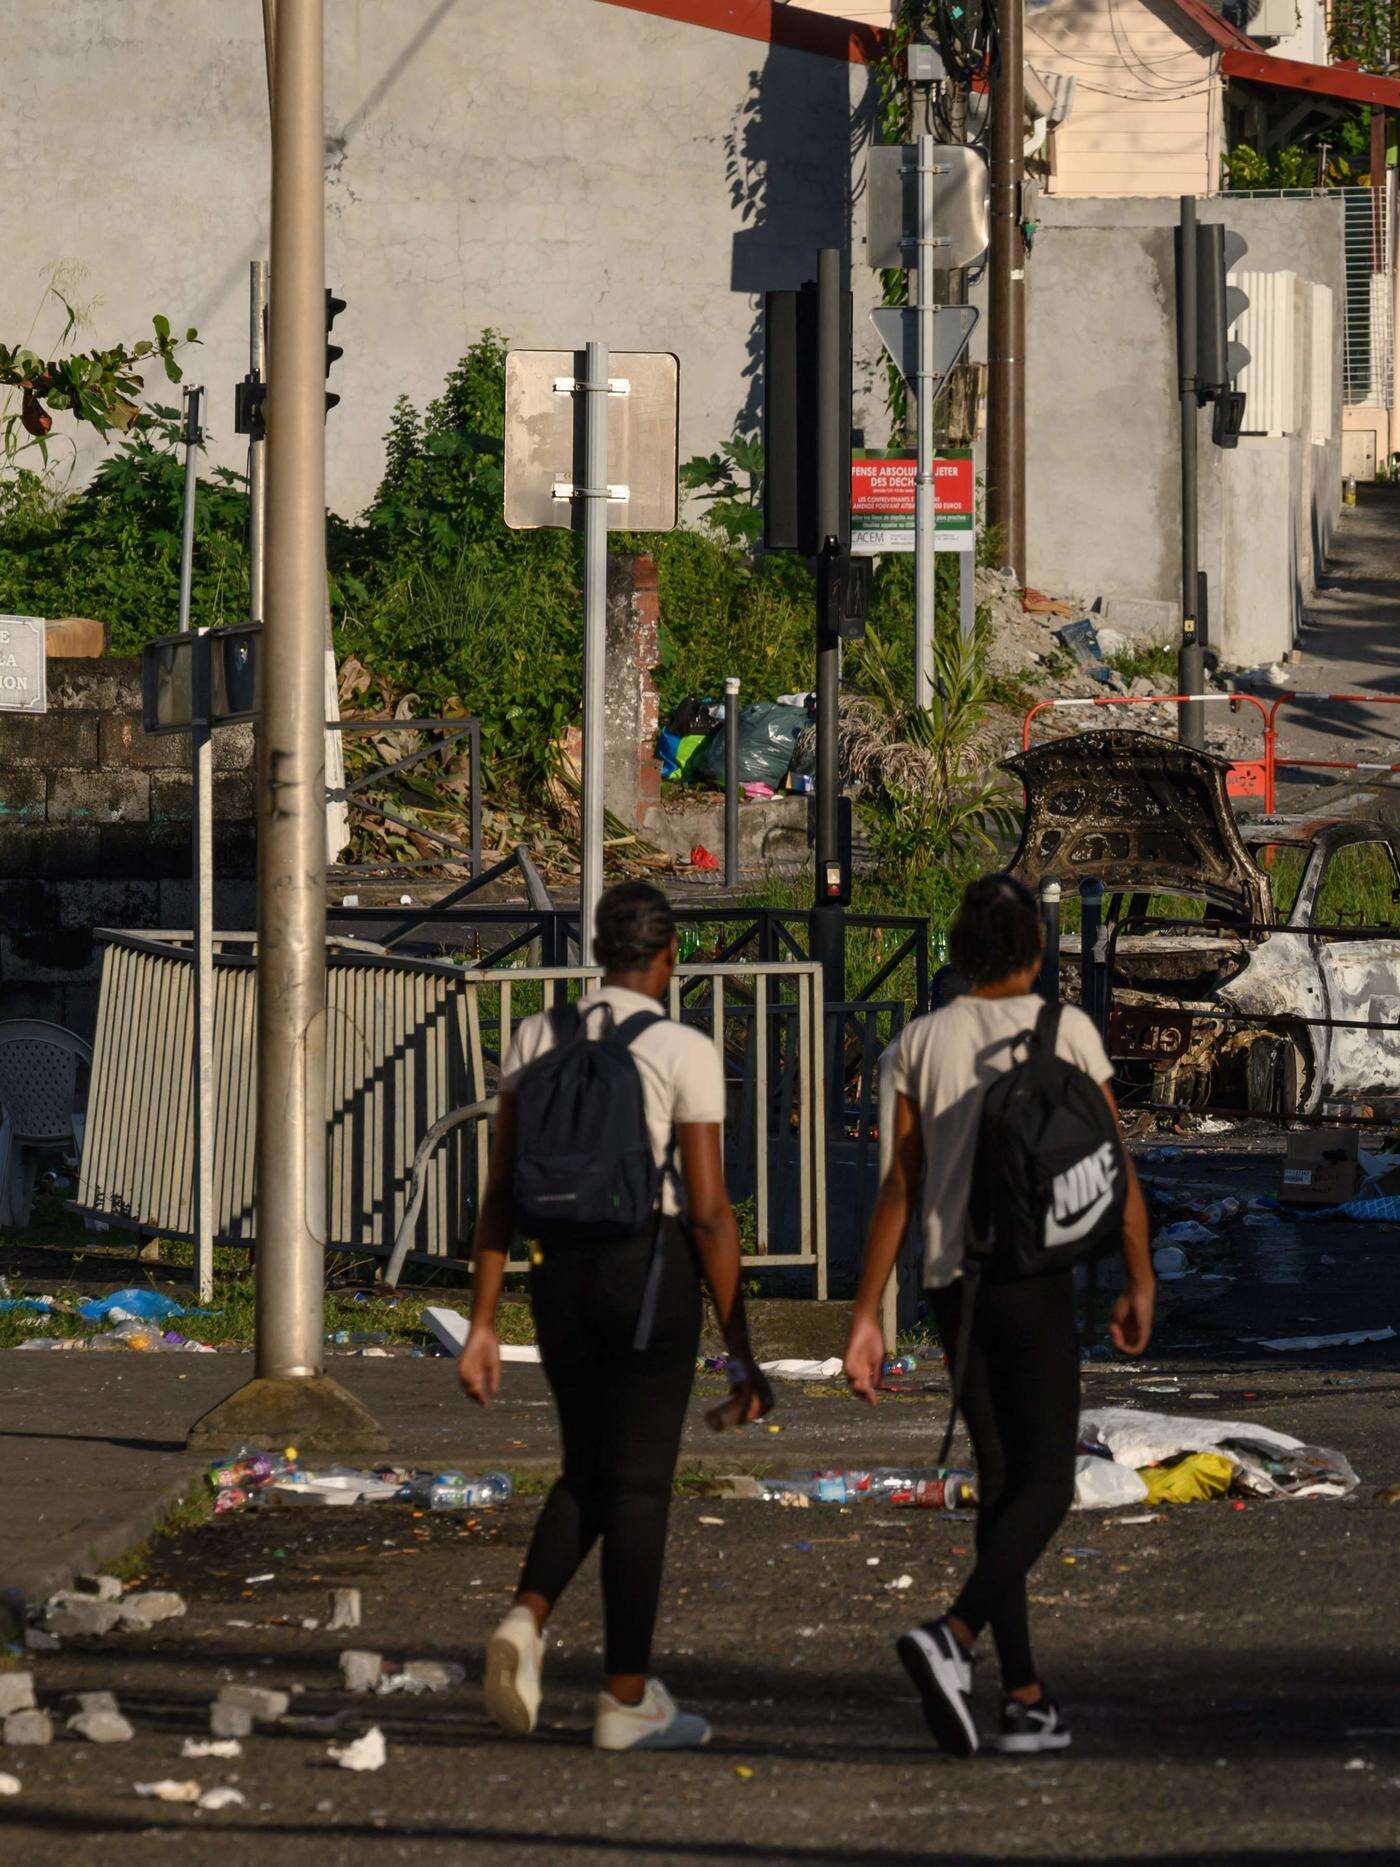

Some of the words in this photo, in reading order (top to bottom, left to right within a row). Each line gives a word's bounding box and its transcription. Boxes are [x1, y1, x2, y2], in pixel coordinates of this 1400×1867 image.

[935, 466, 958, 477] JETER
[871, 477, 887, 487] DES
[889, 477, 917, 487] DECH
[1053, 1141, 1119, 1220] NIKE
